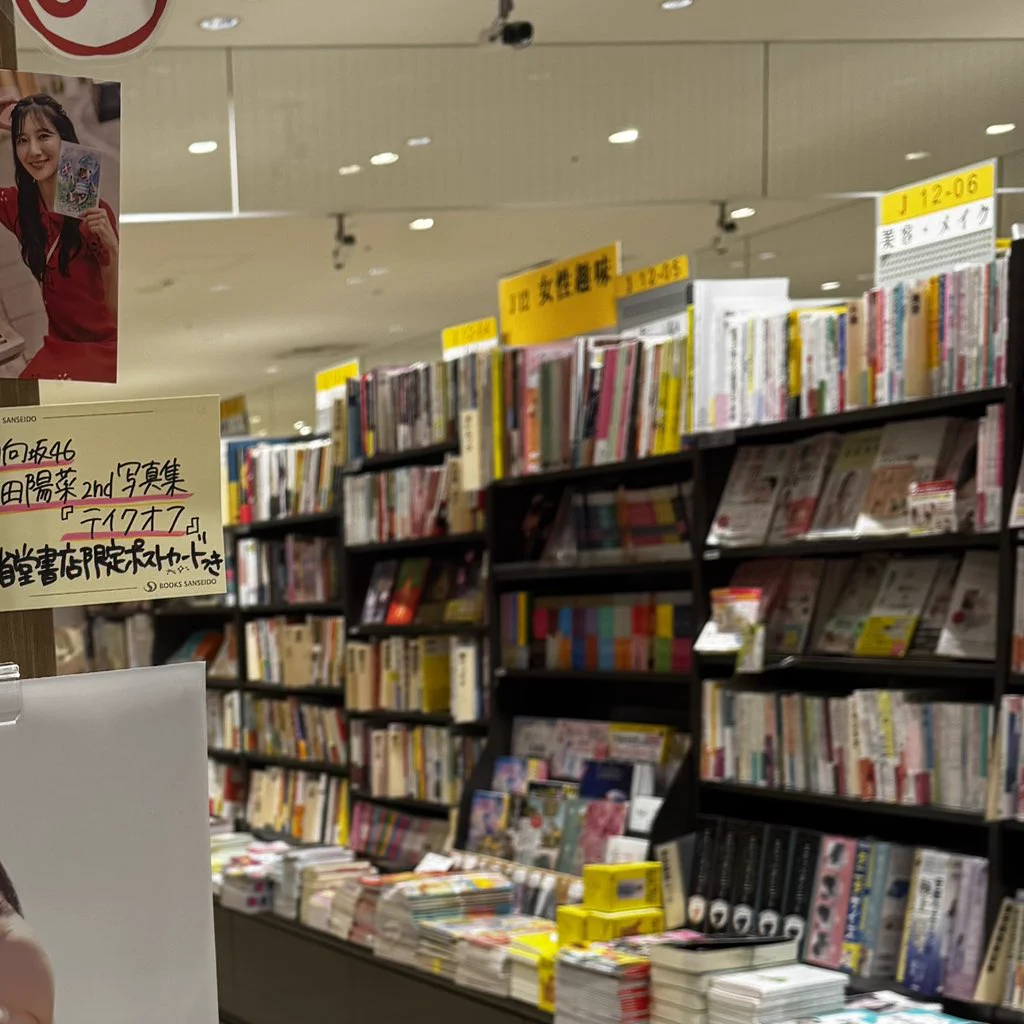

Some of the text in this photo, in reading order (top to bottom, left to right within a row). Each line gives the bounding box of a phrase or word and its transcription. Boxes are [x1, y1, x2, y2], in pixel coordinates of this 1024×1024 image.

[2, 415, 37, 424] SANSEIDO
[159, 578, 217, 590] BOOKS SANSEIDO
